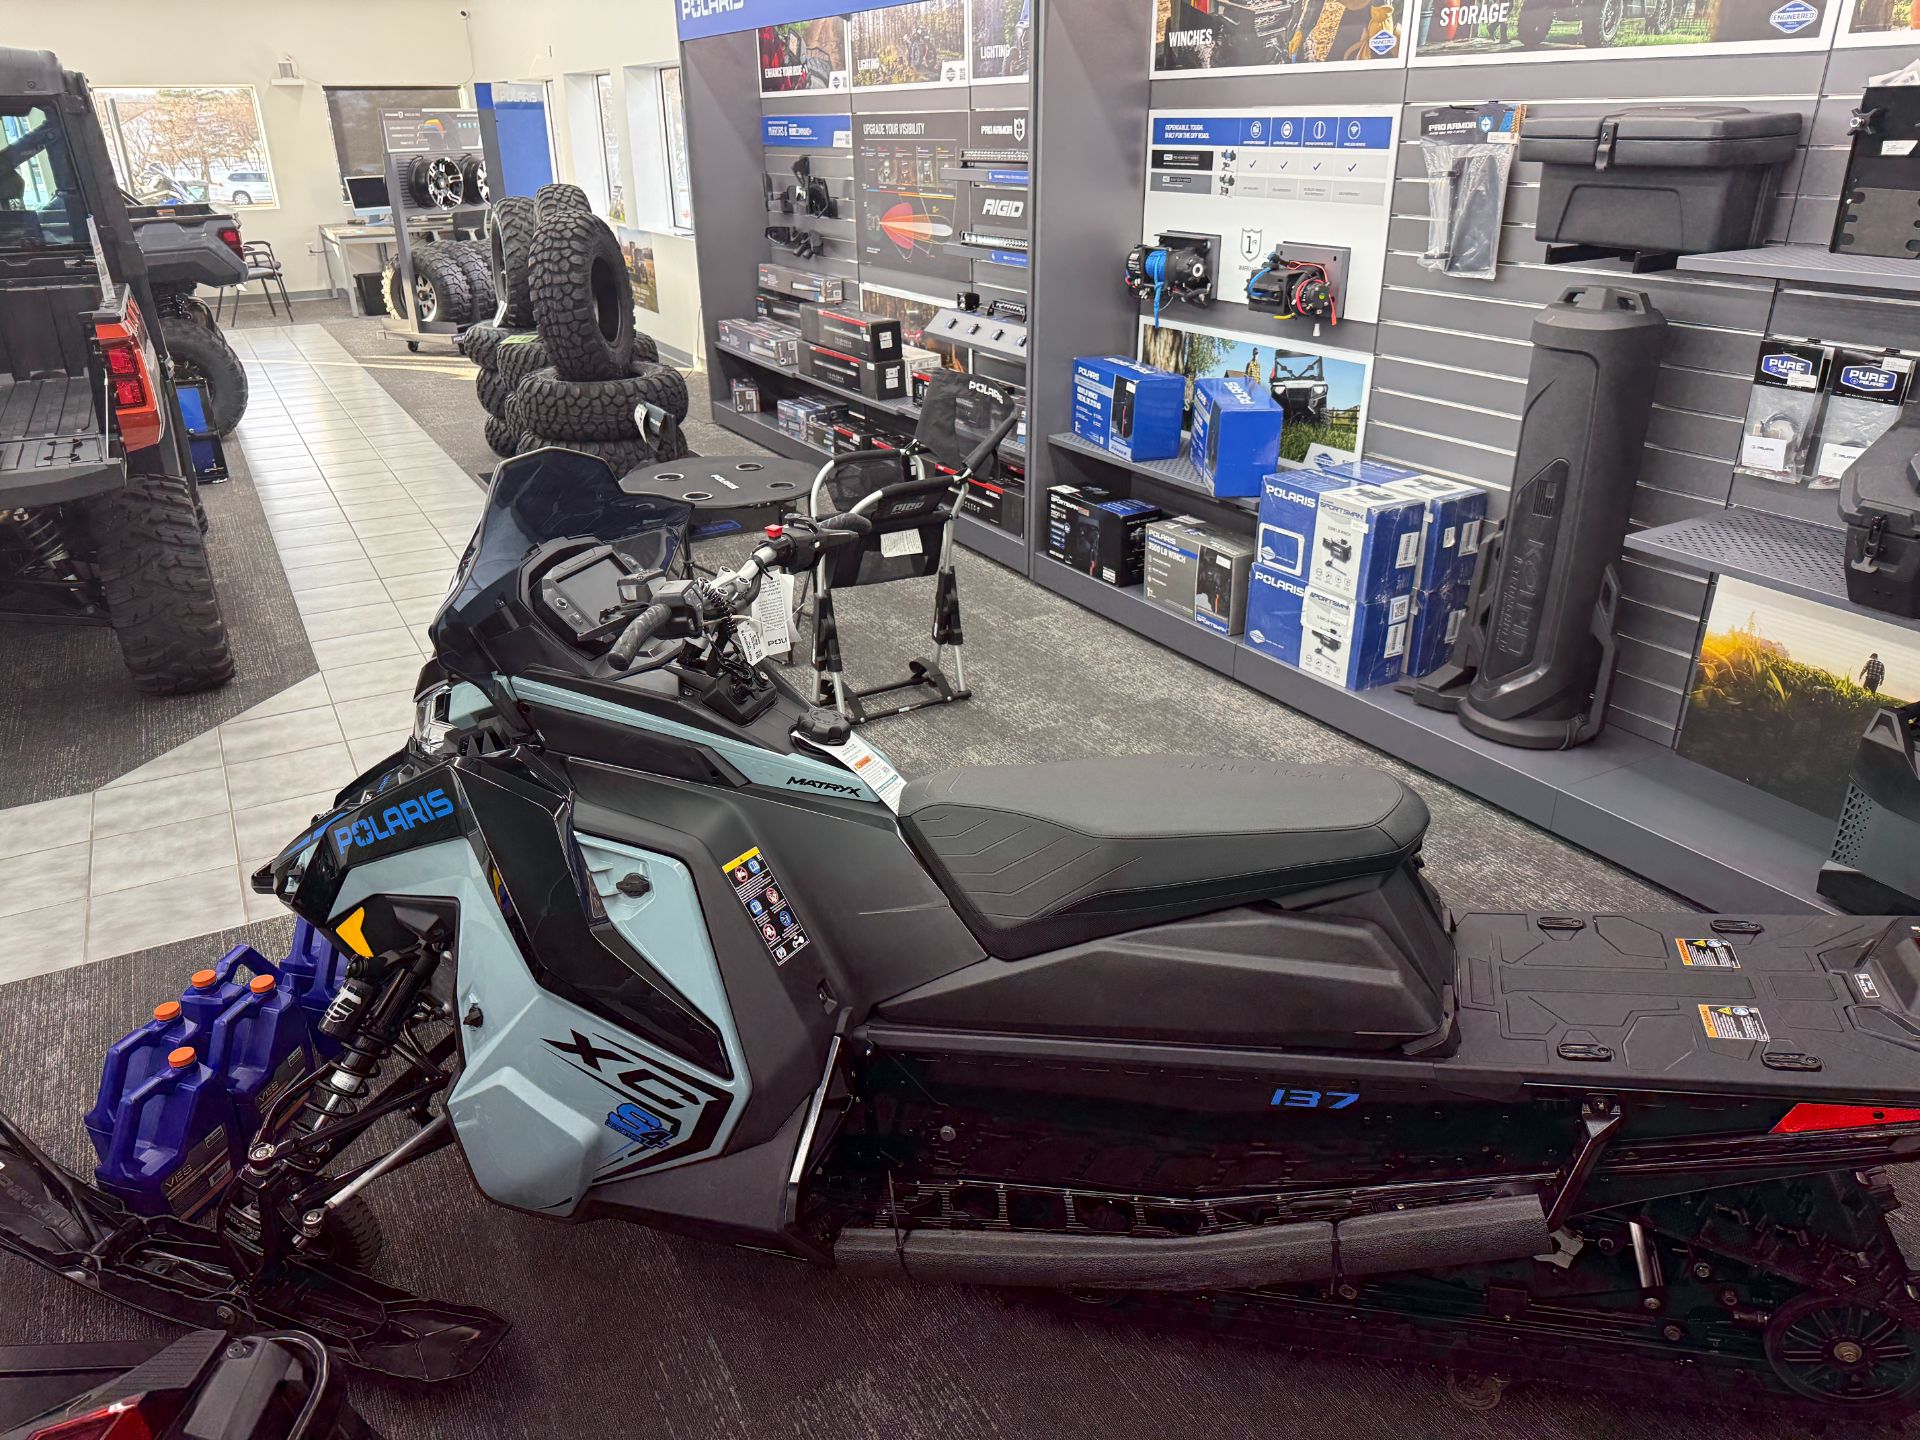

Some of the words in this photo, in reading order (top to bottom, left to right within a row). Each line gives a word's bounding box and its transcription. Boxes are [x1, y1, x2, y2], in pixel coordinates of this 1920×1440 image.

[1439, 3, 1507, 27] STORAGE
[1773, 12, 1815, 21] ENGINEERED
[1168, 28, 1213, 48] WINCHES
[980, 44, 1011, 60] LIGHTING
[857, 58, 879, 71] LIGHTING
[500, 90, 538, 103] POLARIS
[863, 123, 886, 135] UPGRADE
[886, 123, 899, 134] YOUR
[899, 122, 925, 135] VISIBILITY
[1428, 124, 1447, 132] PRO
[1446, 121, 1477, 130] ARMOR
[981, 198, 1024, 218] RIGID
[1078, 366, 1100, 381] POLARIS
[1769, 359, 1806, 372] PURE
[1849, 369, 1890, 384] PURE
[968, 380, 1004, 405] POLARIS
[1266, 485, 1317, 508] POLARIS
[1320, 501, 1365, 521] SPORTSMAN
[1148, 529, 1177, 545] POLARIS
[1168, 550, 1186, 564] WINCH
[1255, 571, 1306, 598] POLARIS
[786, 776, 861, 798] MATRYX
[333, 788, 455, 855] POLARIS
[258, 1080, 280, 1102] VES
[1269, 1087, 1361, 1110] 137
[165, 1165, 193, 1188] VES
